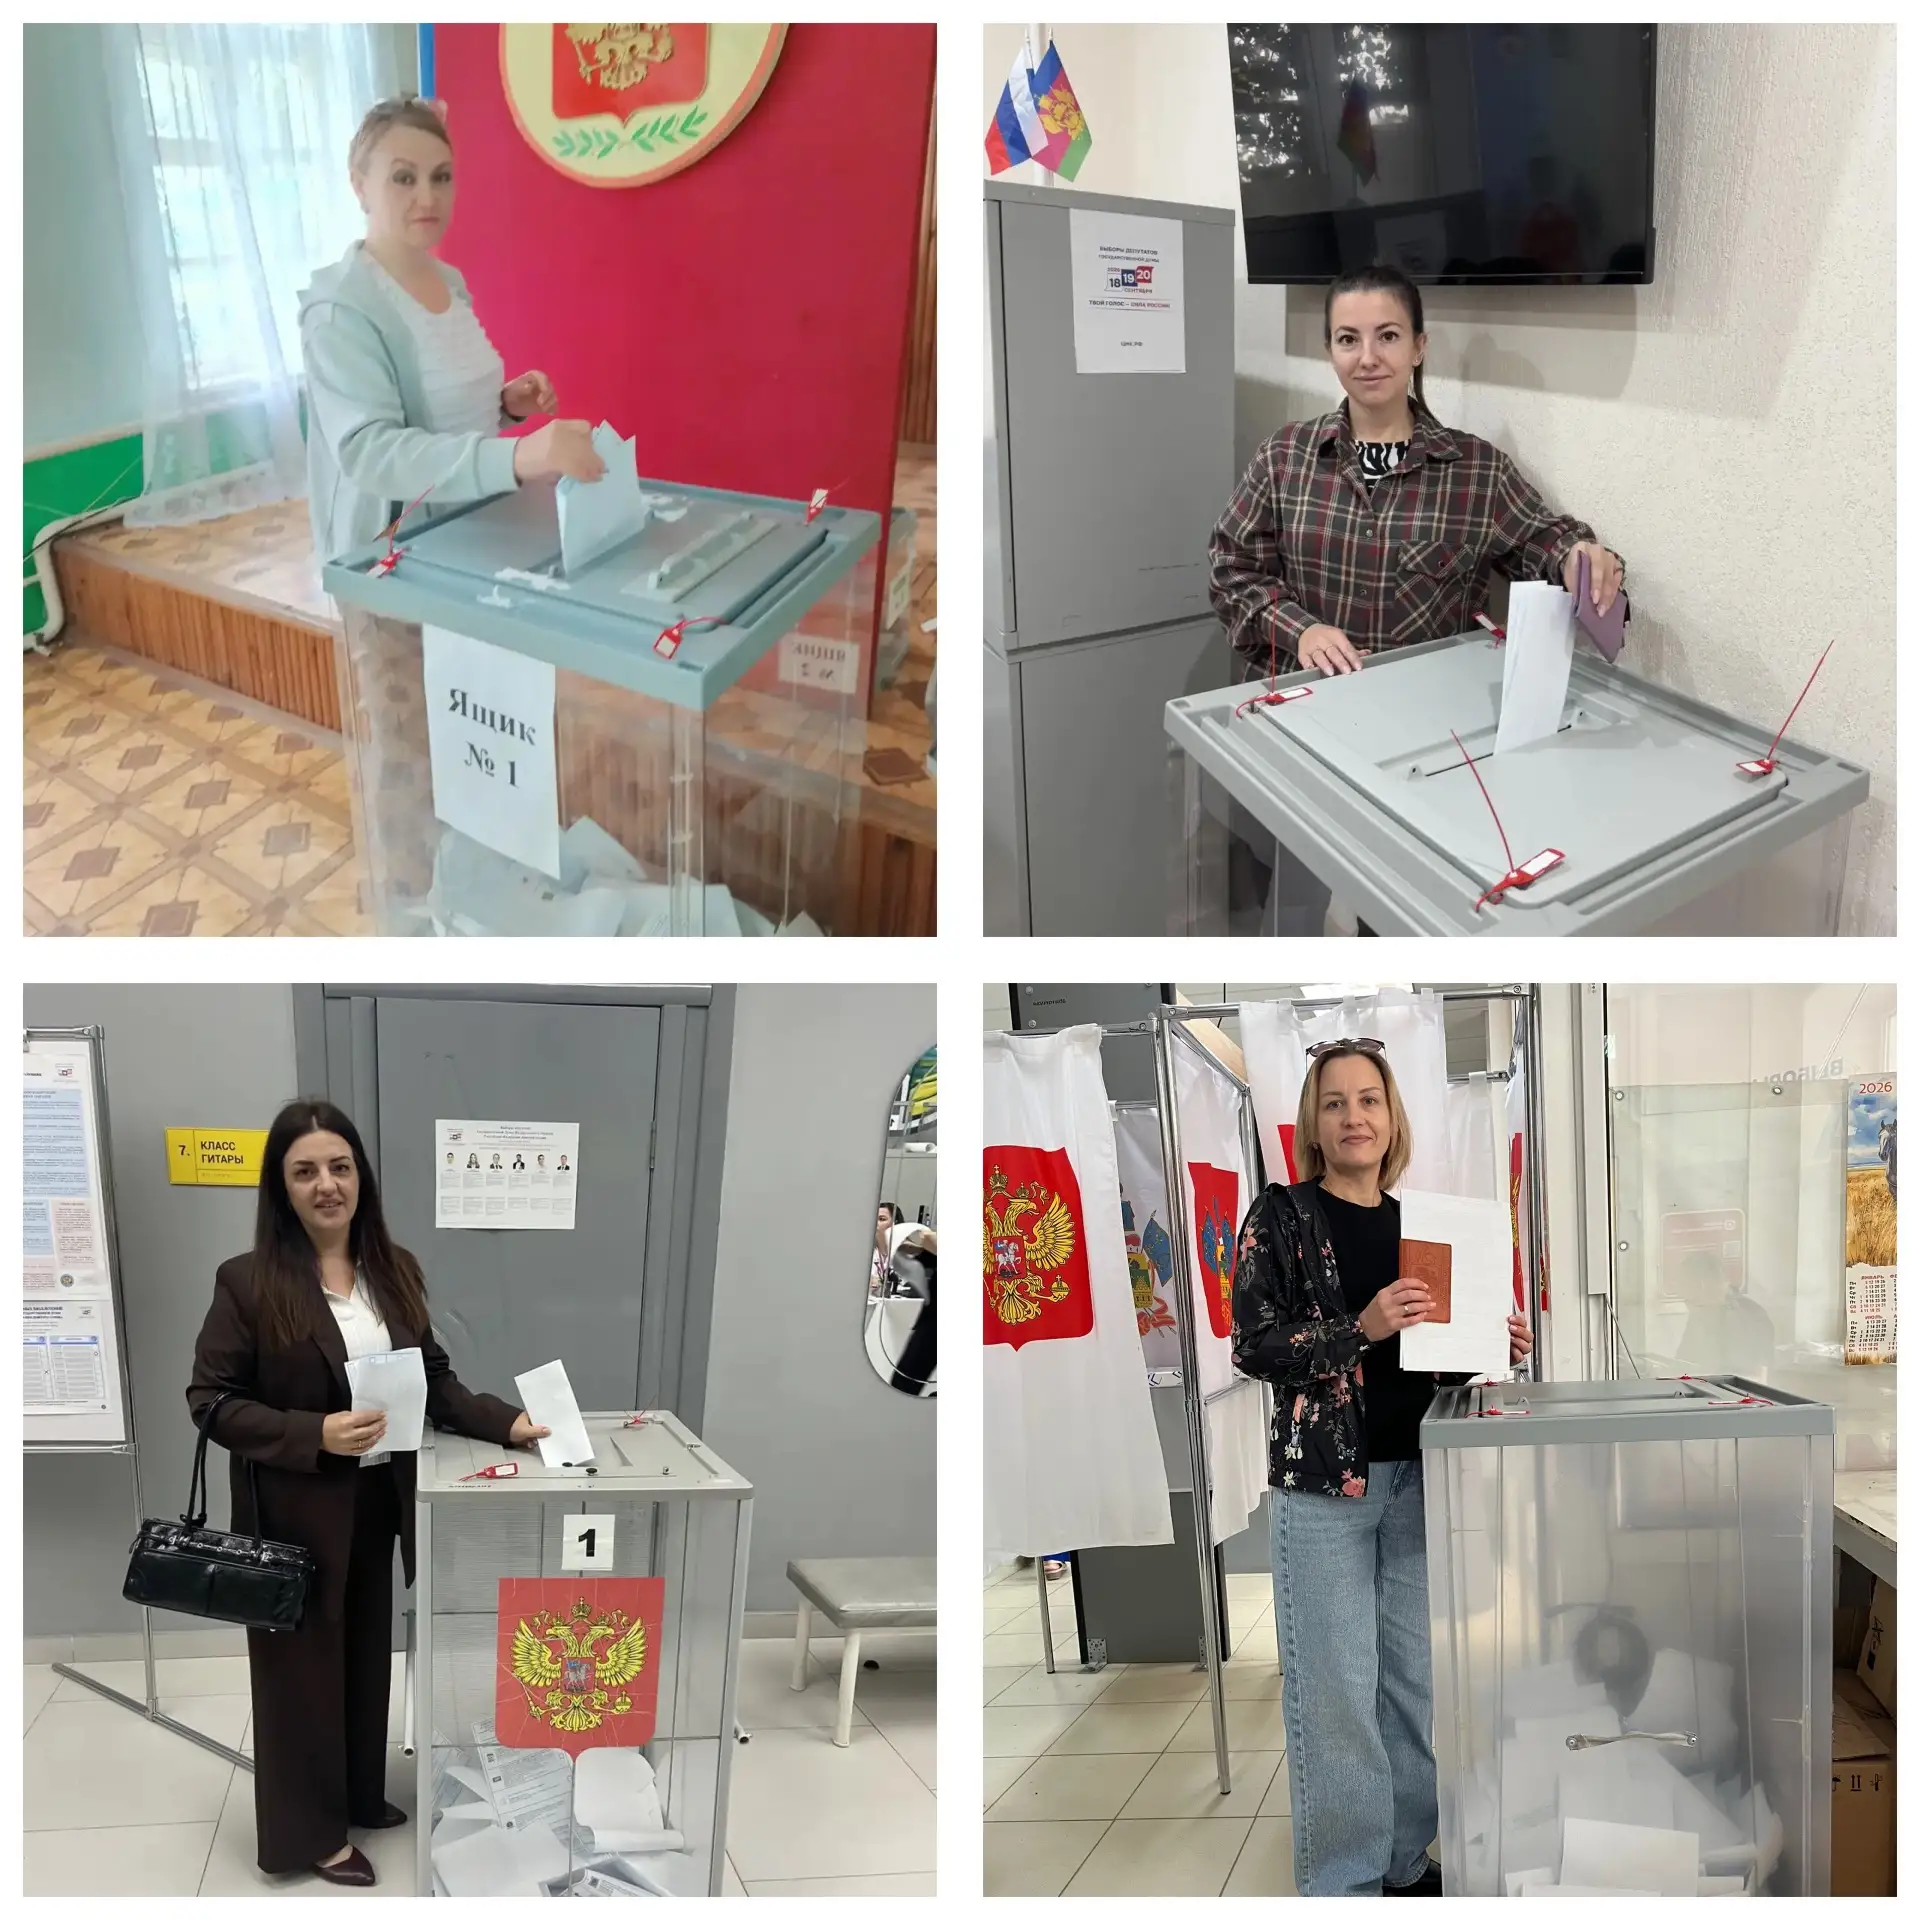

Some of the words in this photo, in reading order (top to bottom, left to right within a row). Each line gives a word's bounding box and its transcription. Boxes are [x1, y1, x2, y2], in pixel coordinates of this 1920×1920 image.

[1109, 278, 1121, 288] 18
[1123, 273, 1134, 283] 19
[1136, 270, 1150, 280] 20
[448, 688, 536, 746] Ящик
[465, 741, 495, 777] №
[508, 761, 519, 788] 1
[1859, 1083, 1892, 1094] 2026
[179, 1145, 190, 1156] 7.
[201, 1141, 236, 1151] КЛАСС
[202, 1154, 244, 1164] ГИТАРЫ
[578, 1529, 596, 1557] 1
